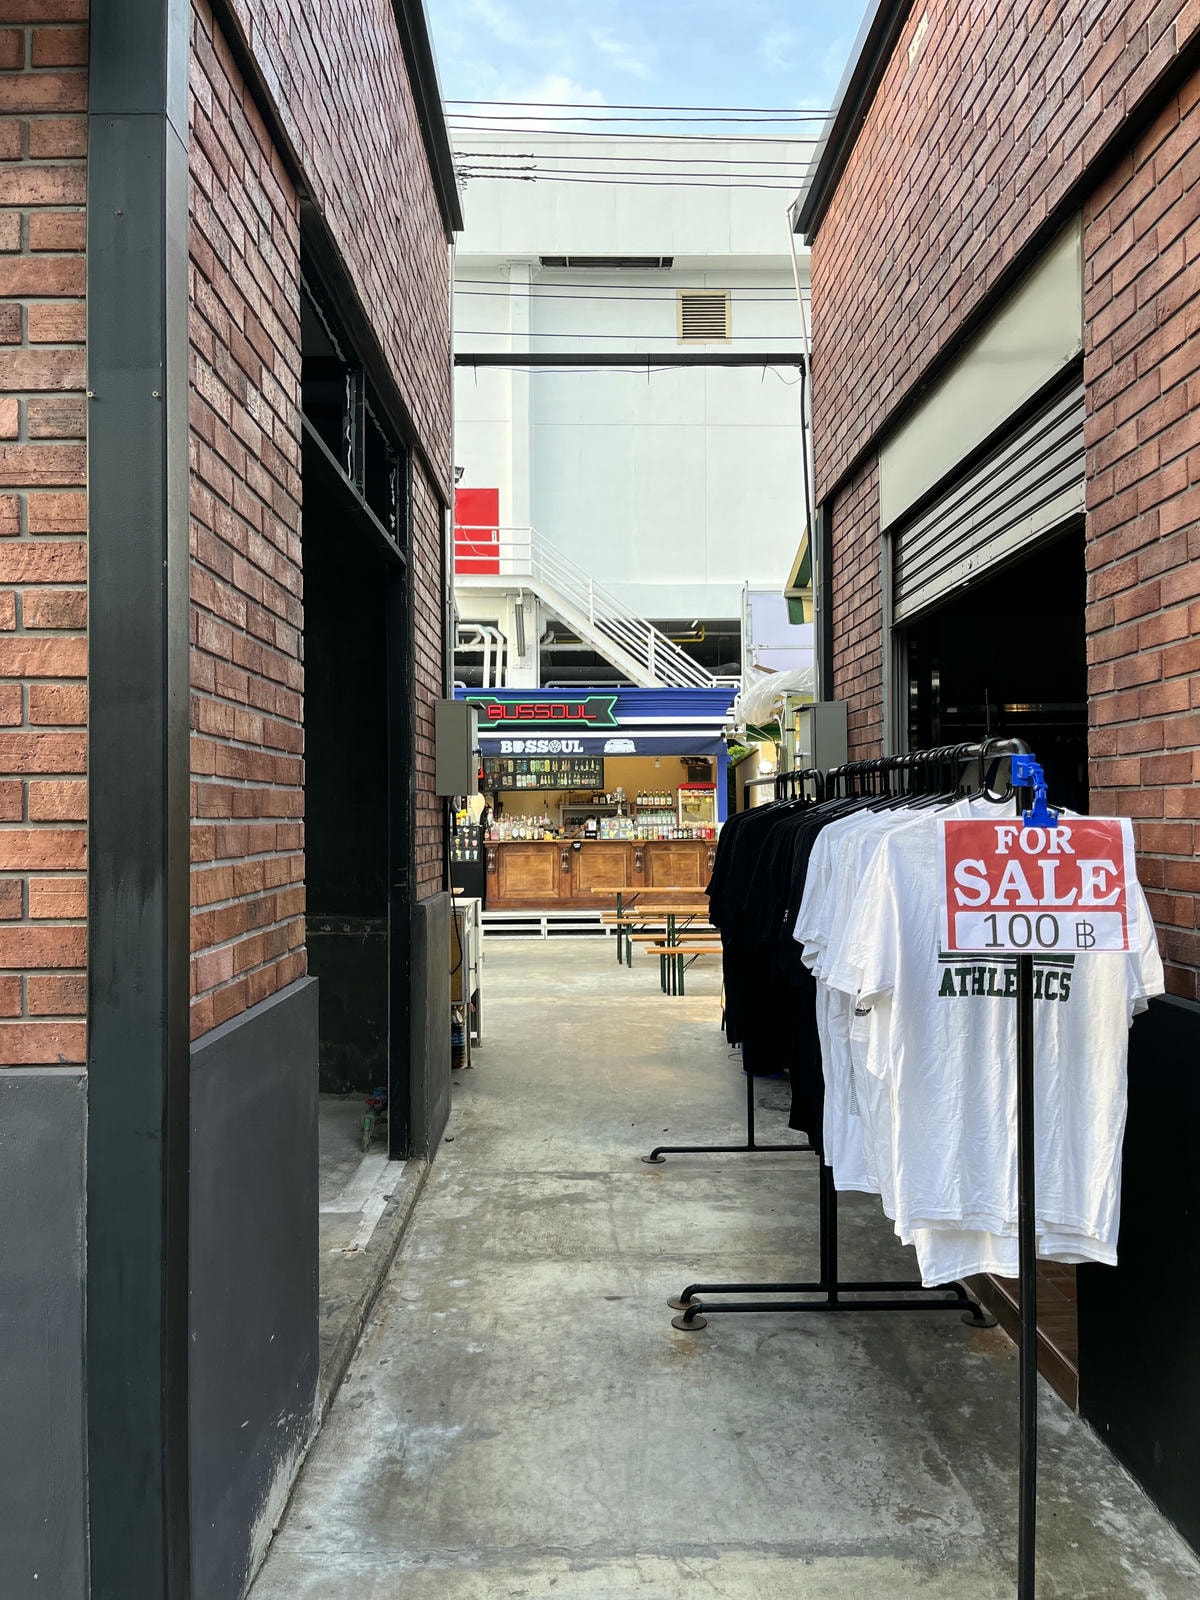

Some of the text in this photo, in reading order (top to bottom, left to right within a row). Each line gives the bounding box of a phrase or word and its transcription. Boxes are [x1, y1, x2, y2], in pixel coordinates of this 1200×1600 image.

[487, 704, 597, 719] BUSSOUL
[994, 825, 1075, 855] FOR
[953, 858, 1122, 907] SALE
[983, 913, 1060, 948] 100
[938, 966, 1072, 1002] ATHLEICS
